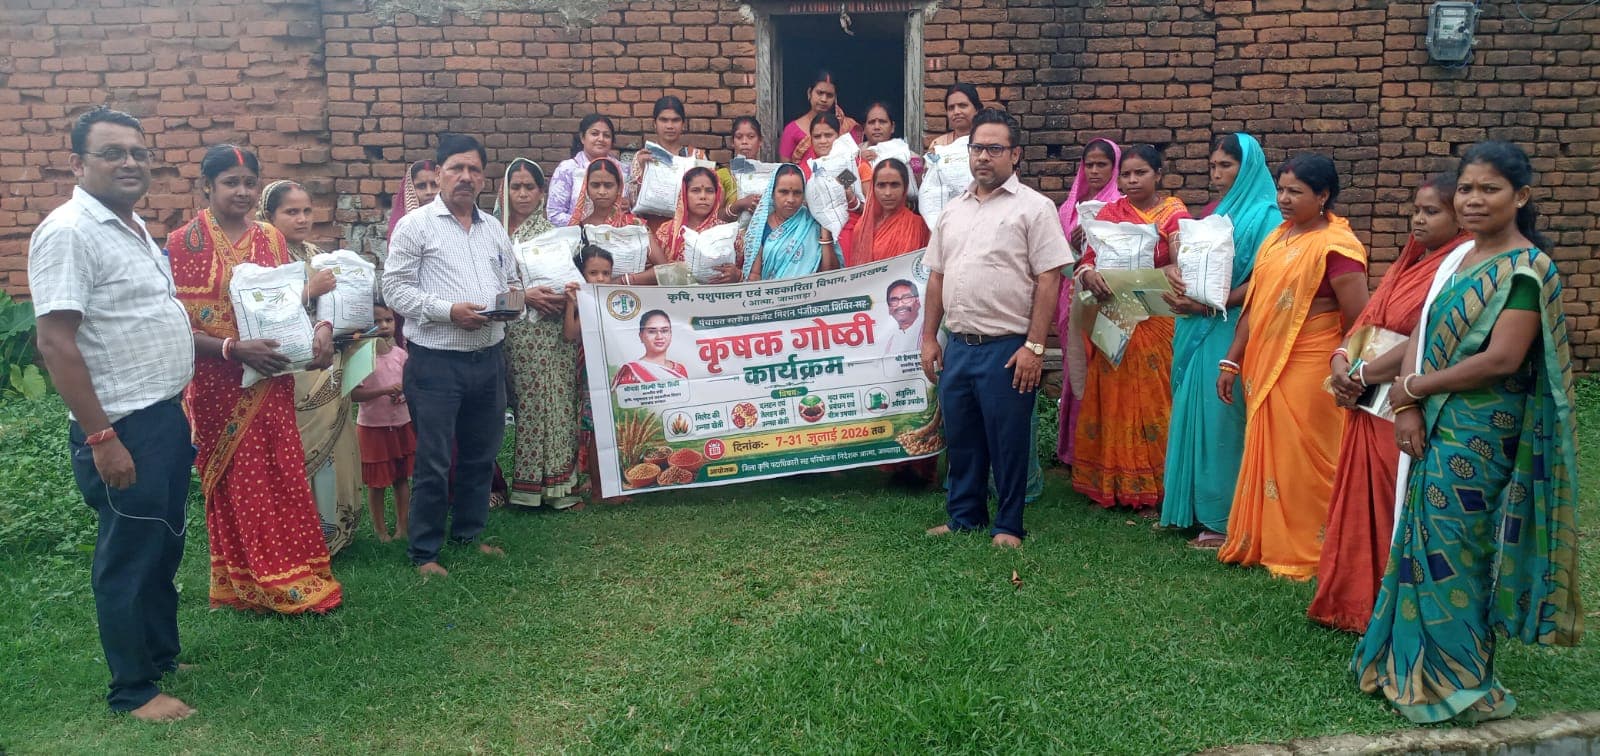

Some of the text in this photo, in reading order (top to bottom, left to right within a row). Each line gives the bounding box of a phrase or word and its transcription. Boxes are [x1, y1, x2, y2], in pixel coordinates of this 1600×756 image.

[697, 291, 741, 303] पशुपालन
[746, 287, 761, 297] एवं
[765, 282, 813, 296] सहकारिता
[816, 278, 847, 288] विभाग,
[850, 265, 888, 280] झारखण्ड
[696, 312, 876, 374] कृषक गोष्ठी
[743, 354, 845, 385] कार्यक्रम
[711, 410, 720, 418] की
[775, 434, 802, 447] 7-31
[806, 427, 838, 446] जुलाई
[841, 427, 869, 440] 2026
[871, 425, 886, 435] तक
[742, 463, 757, 472] जिला
[757, 461, 770, 472] कृषि
